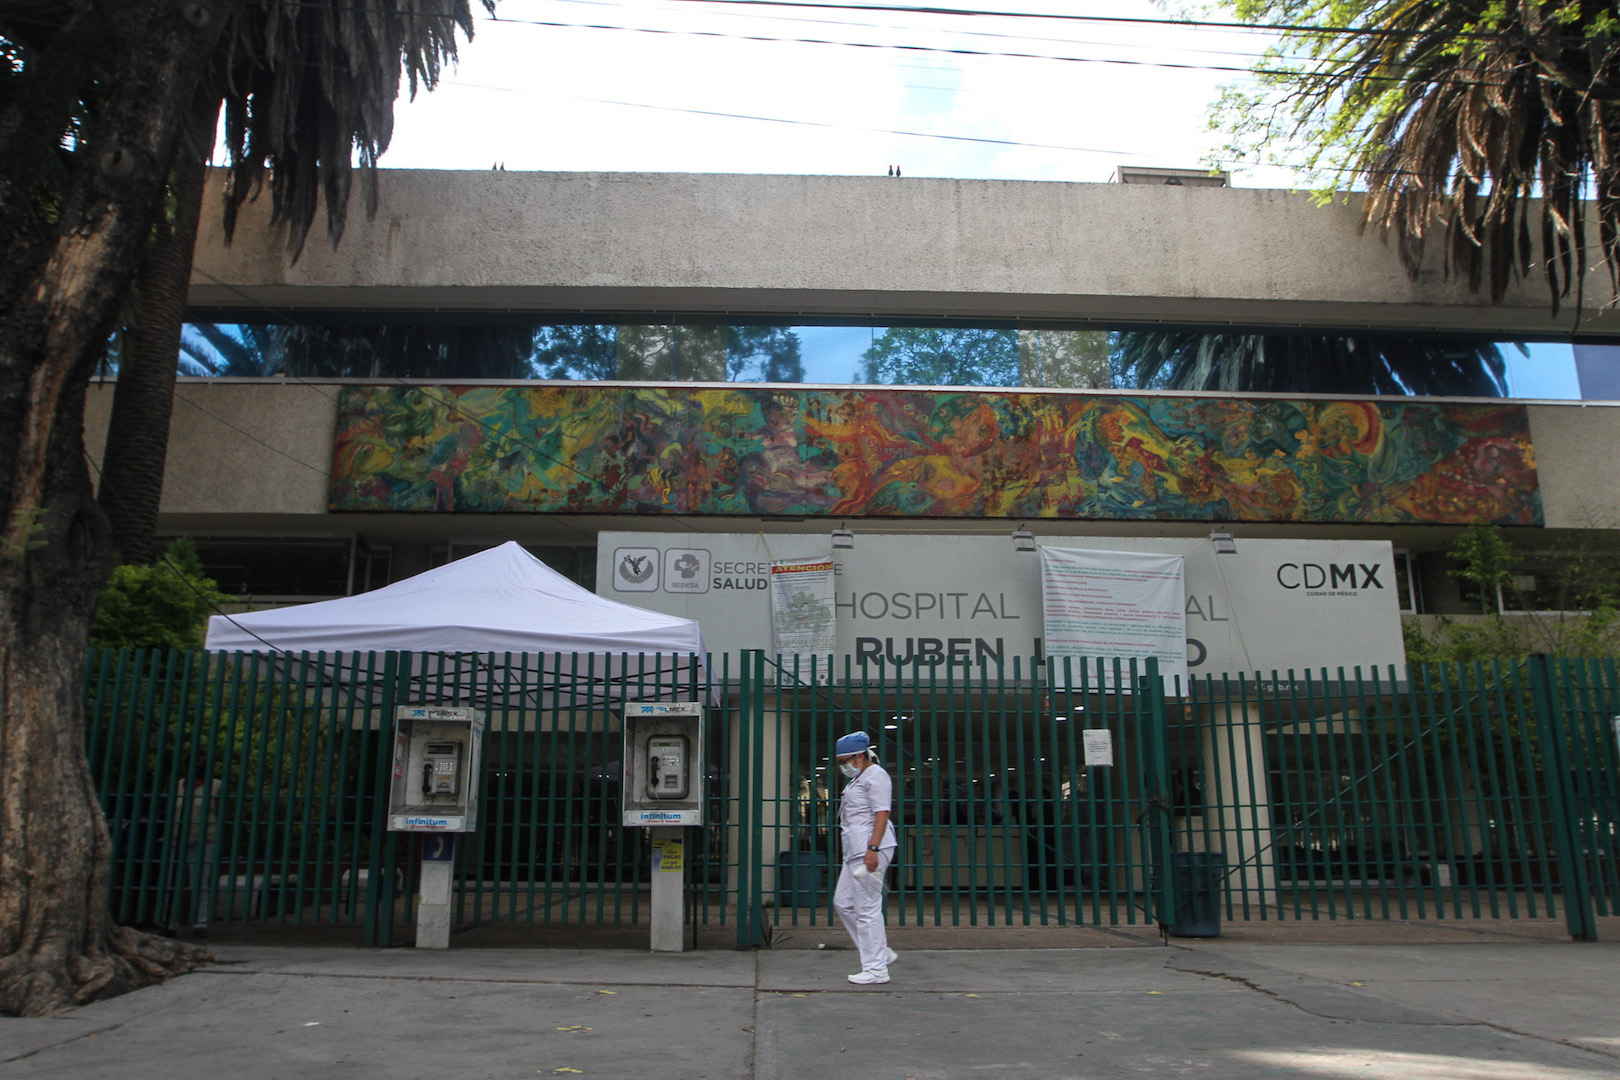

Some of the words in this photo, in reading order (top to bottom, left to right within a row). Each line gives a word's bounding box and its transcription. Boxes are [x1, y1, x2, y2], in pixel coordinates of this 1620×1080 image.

[775, 563, 833, 573] ATENCIÓN
[1277, 563, 1384, 589] CDMX
[713, 577, 768, 590] SALUD
[834, 591, 1021, 620] HOSPITAL
[856, 637, 1005, 666] RUBEN
[405, 817, 447, 825] infinitum
[640, 812, 681, 820] infinitum
